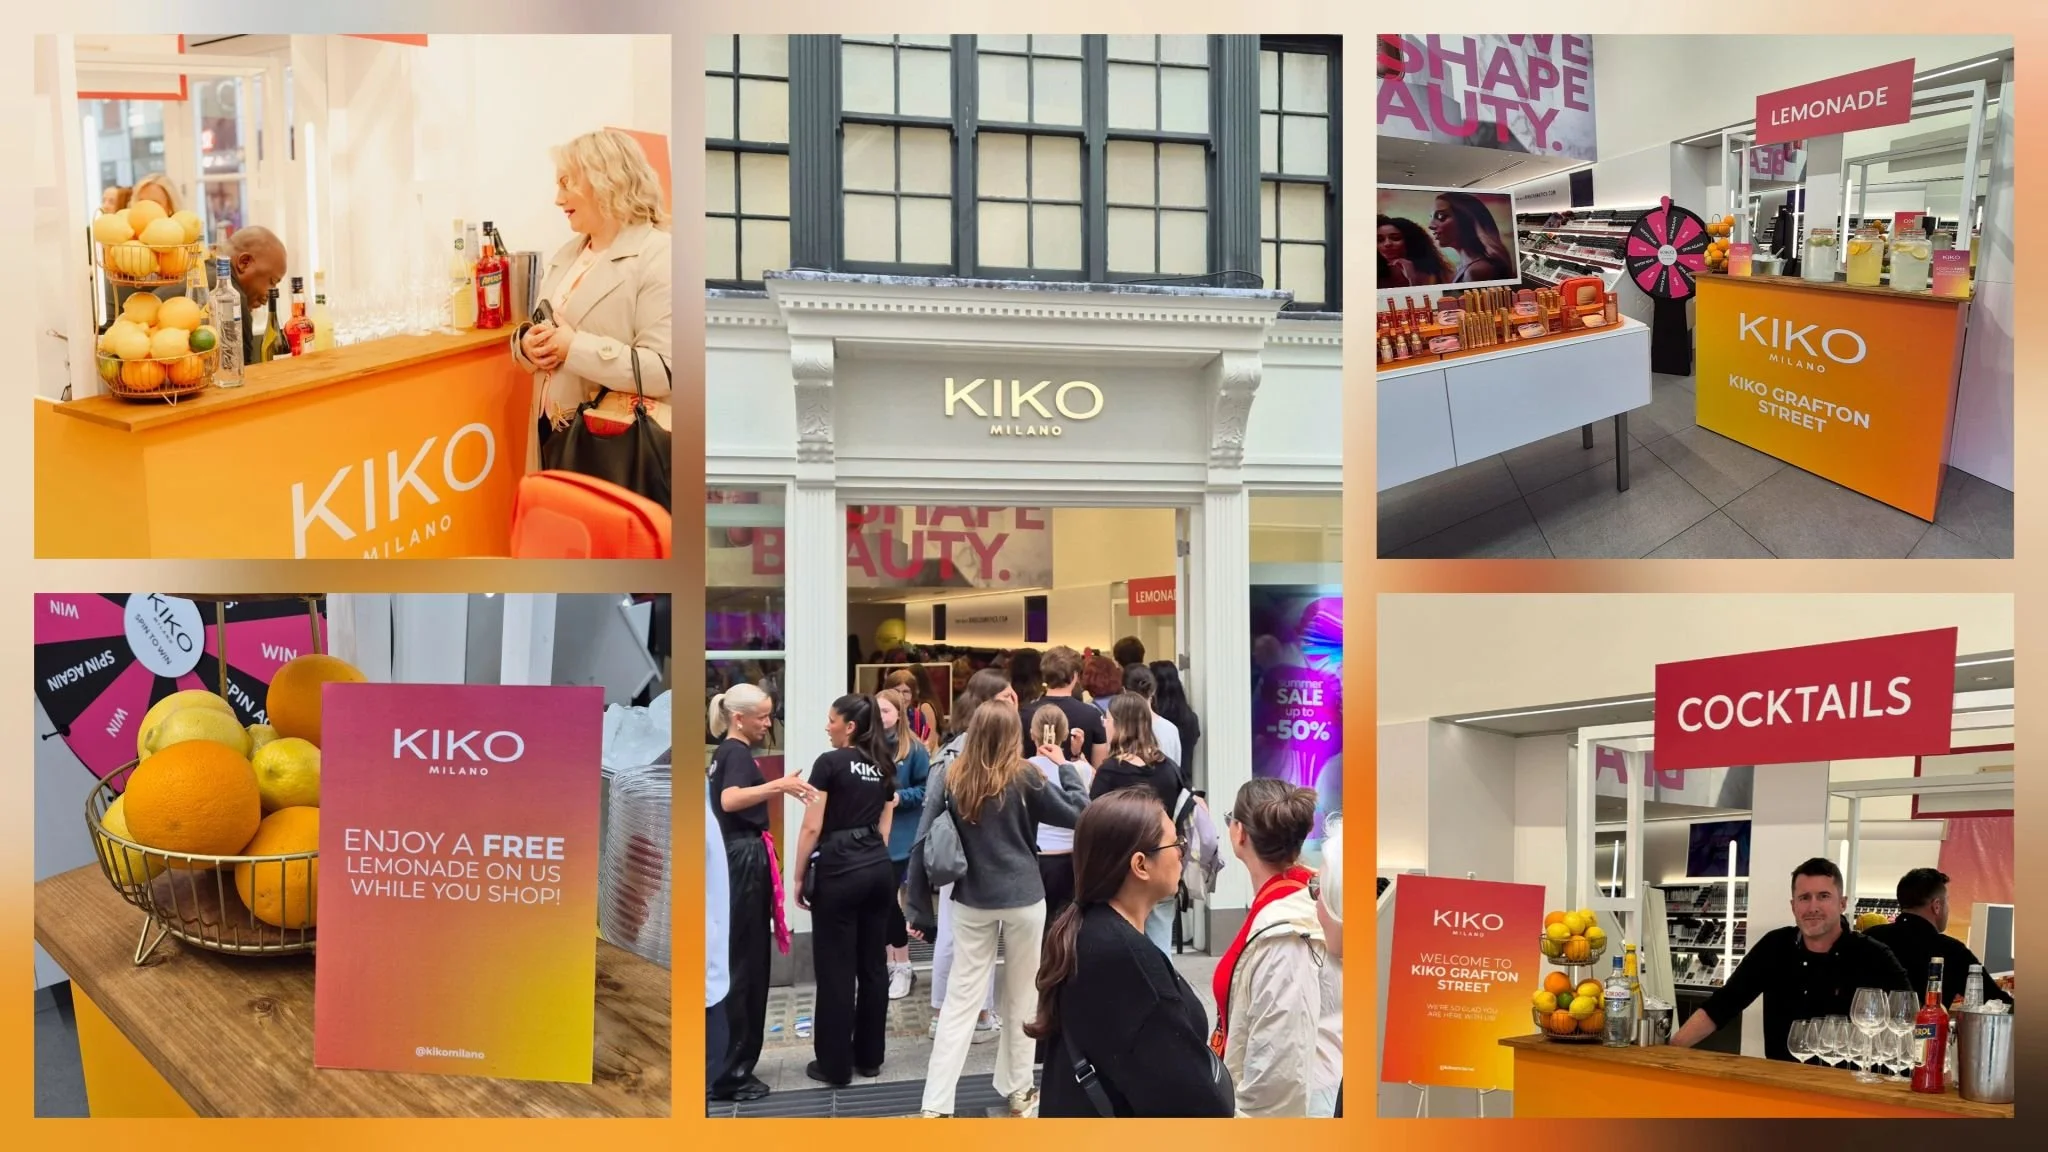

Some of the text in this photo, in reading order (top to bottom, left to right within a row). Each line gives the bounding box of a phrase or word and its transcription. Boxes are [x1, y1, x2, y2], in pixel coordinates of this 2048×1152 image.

[1377, 34, 1590, 112] SHAPE
[1771, 86, 1889, 126] LEMONADE
[1739, 312, 1867, 364] KIKO
[1769, 353, 1826, 373] MILANO
[945, 377, 1104, 420] KIKO
[1729, 374, 1870, 429] KIKO GRAFTON
[990, 425, 1062, 436] MILANO
[1758, 399, 1827, 432] STREET
[291, 422, 496, 559] KIKO
[363, 515, 452, 559] MILANO
[50, 600, 79, 619] WIN
[147, 593, 193, 653] KIKO
[135, 613, 172, 665] SPIN TO WIN
[261, 642, 297, 662] WIN
[47, 650, 115, 692] SPIN AGAIN
[1277, 688, 1323, 706] SALE
[1677, 676, 1912, 732] COCKTAILS
[105, 708, 128, 738] WIN
[1286, 707, 1314, 718] up to
[393, 728, 525, 762] KIKO
[429, 766, 488, 776] MILANO
[345, 828, 565, 860] ENJOY A FREE
[347, 856, 561, 883] LEMONADE ON US
[351, 878, 561, 905] WHILE YOU SHOP!
[1433, 909, 1504, 931] KIKO
[1411, 965, 1519, 983] KIKO GRAFTON
[1420, 953, 1512, 969] WELCOME TO
[1437, 980, 1491, 993] STREET
[416, 1046, 485, 1060] @kikomilano
